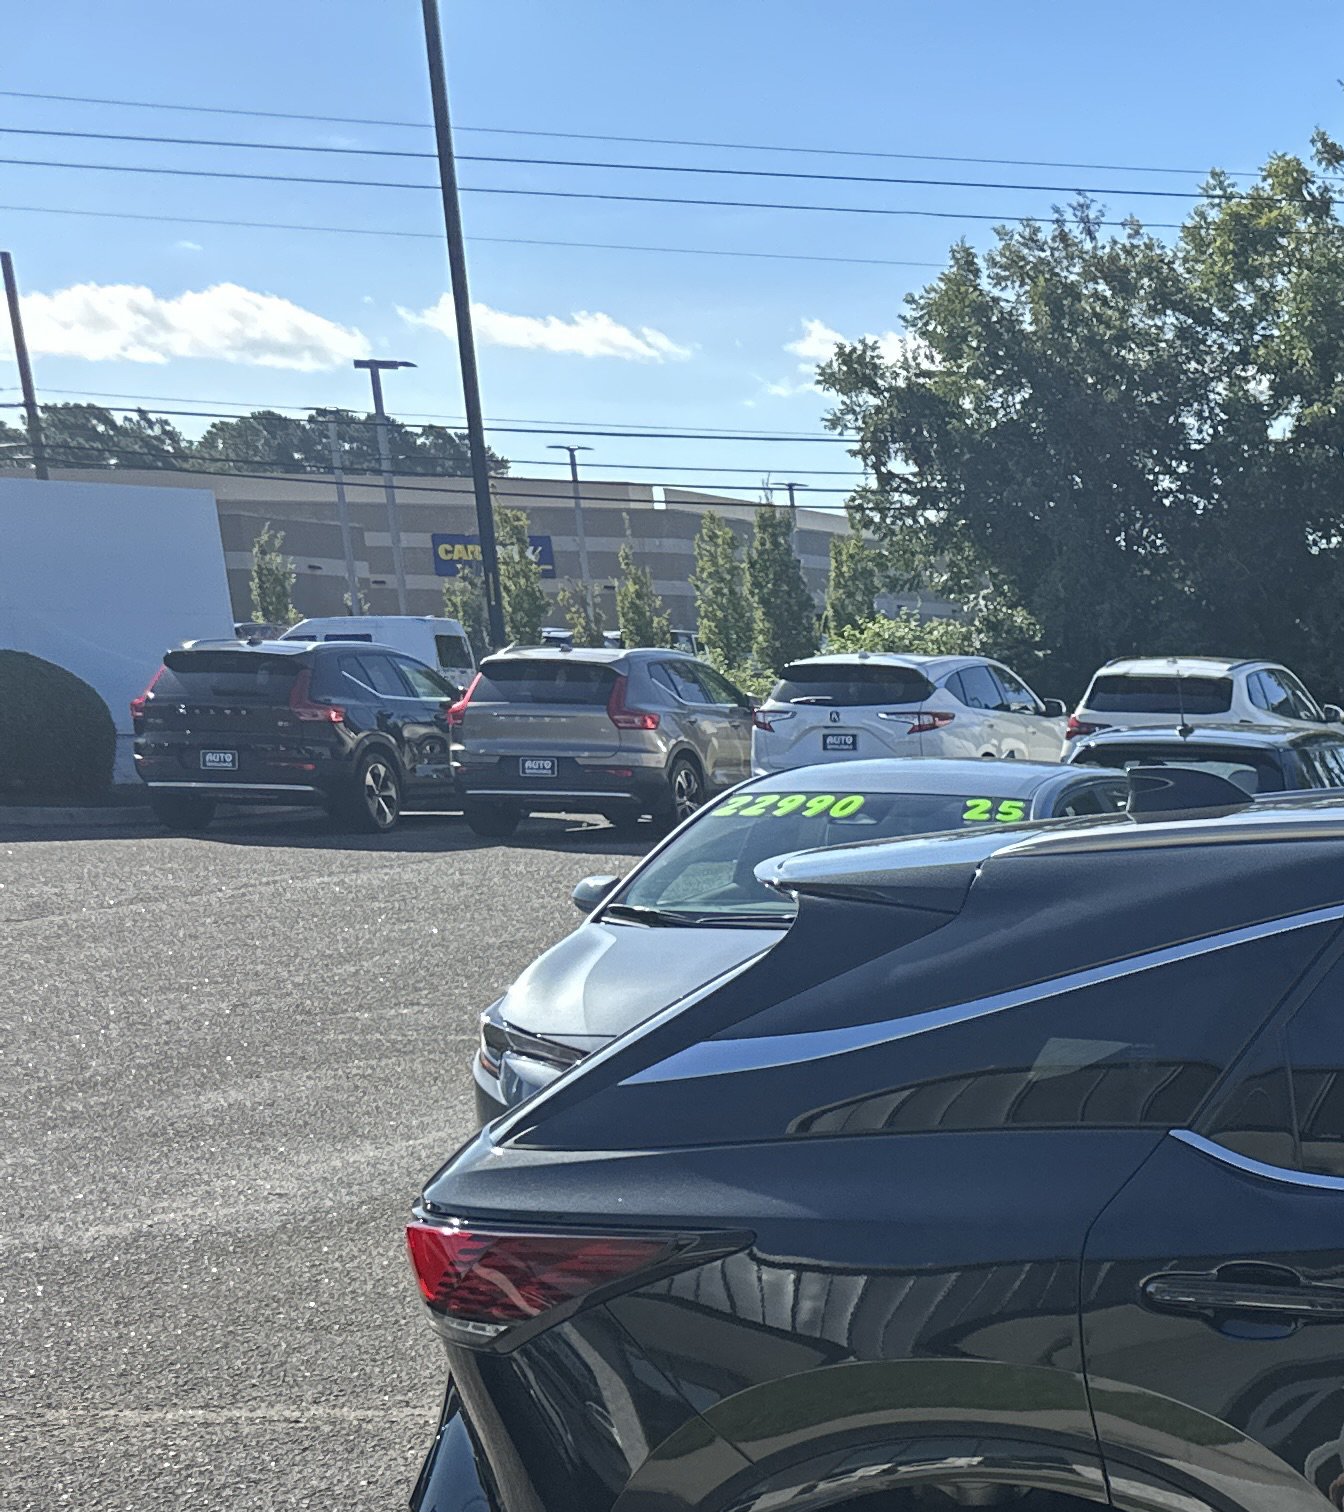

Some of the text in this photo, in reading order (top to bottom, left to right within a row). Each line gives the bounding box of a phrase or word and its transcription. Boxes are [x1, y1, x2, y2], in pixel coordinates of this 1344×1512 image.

[206, 753, 233, 762] AUTO
[712, 794, 1026, 822] 22990 25
